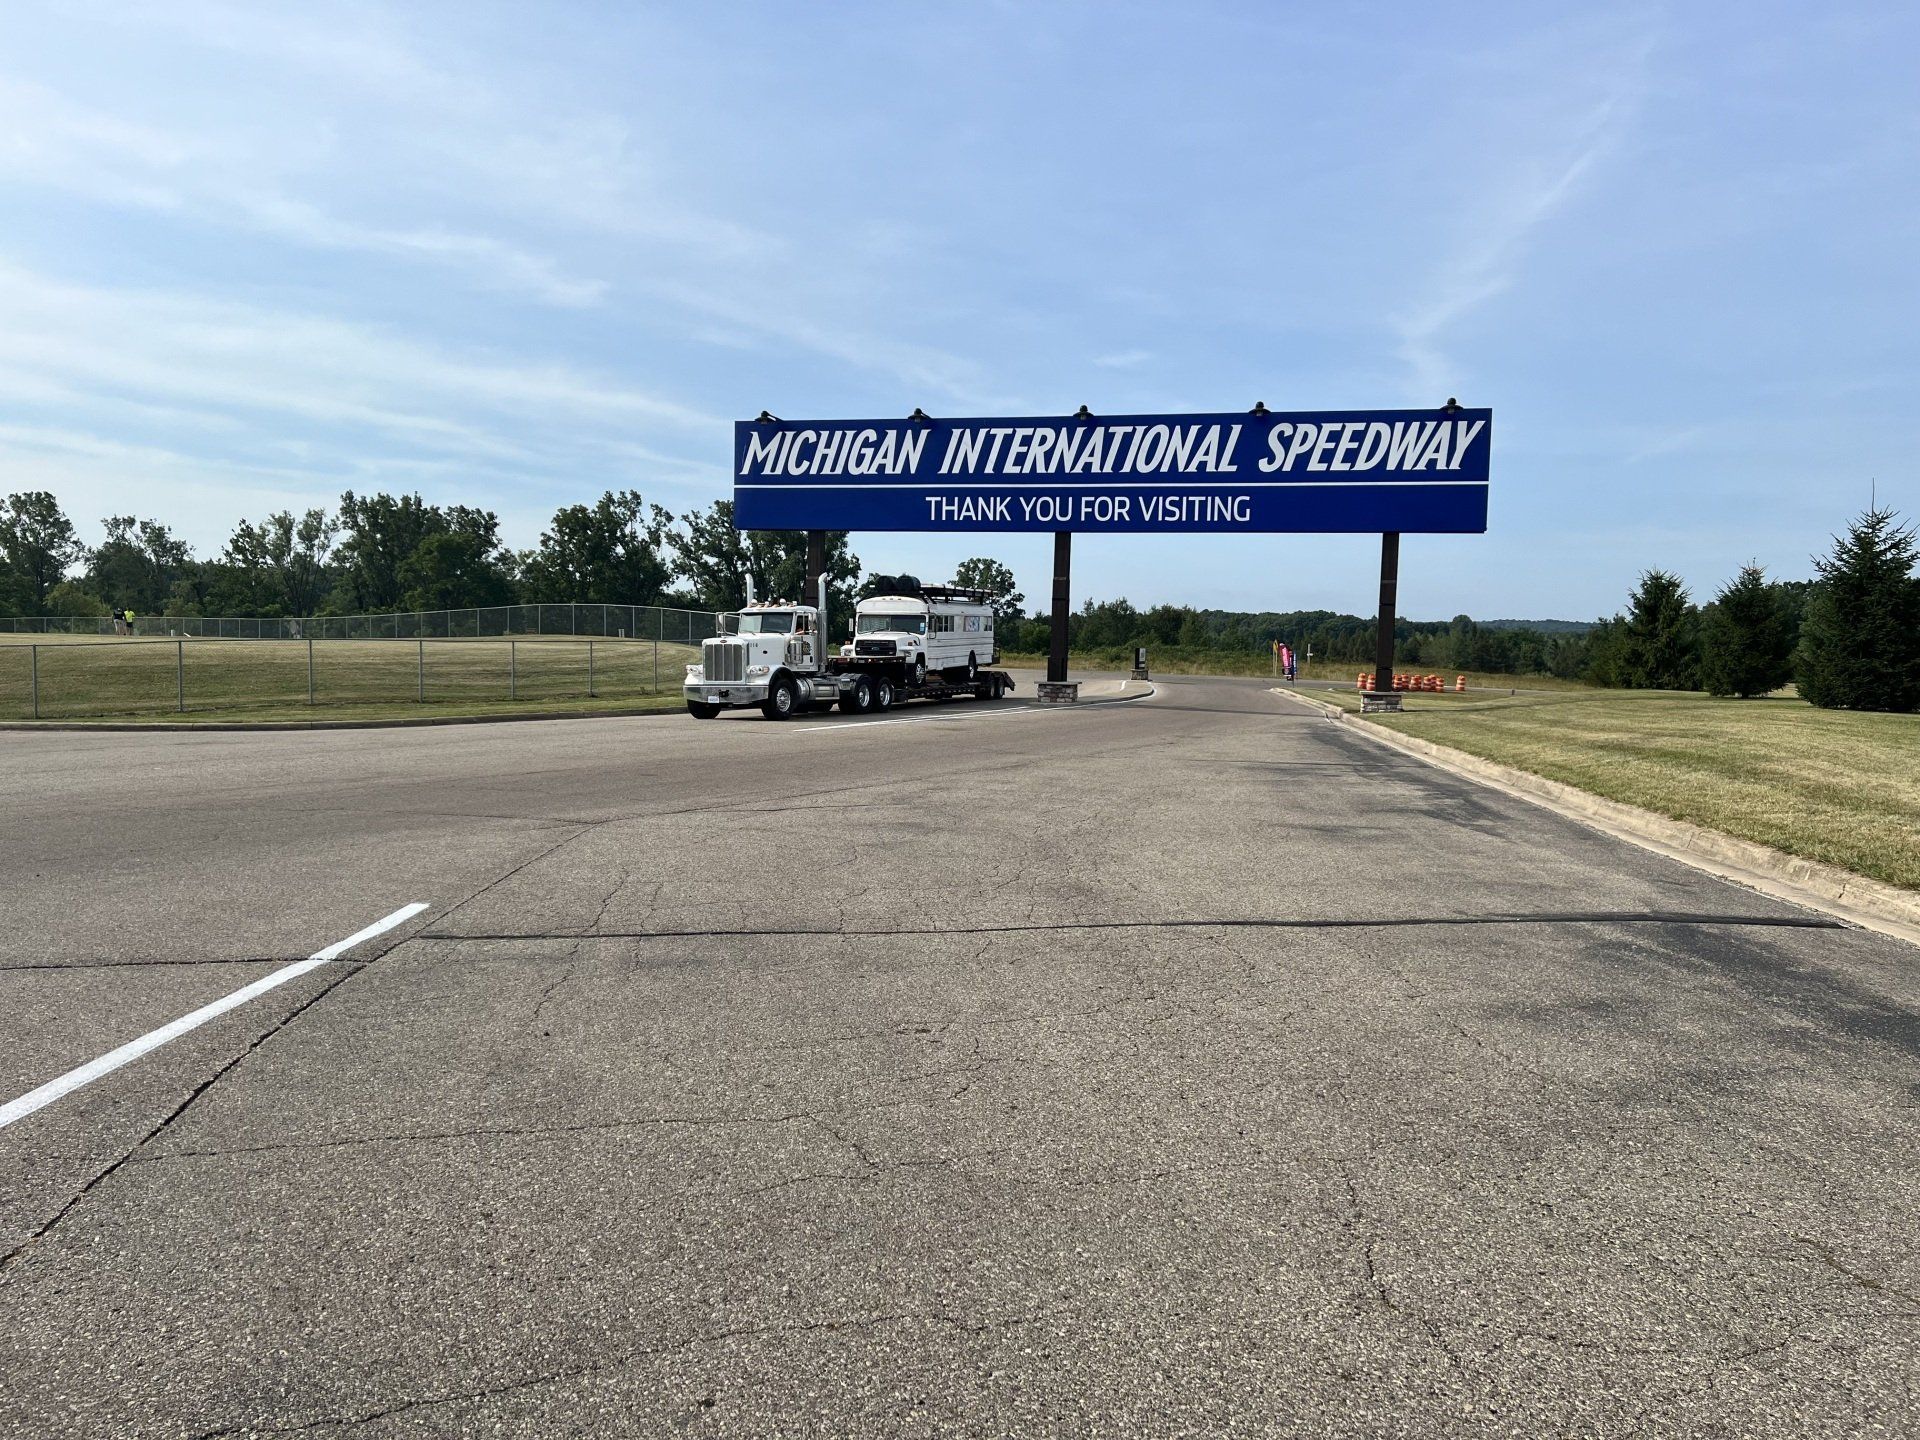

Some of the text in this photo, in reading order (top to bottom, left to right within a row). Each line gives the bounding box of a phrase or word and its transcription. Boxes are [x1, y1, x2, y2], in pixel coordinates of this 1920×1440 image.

[740, 421, 1486, 475] MICHIGAN INTERNATIONAL SPEEDWAY
[925, 495, 1251, 522] THANK YOU FOR VISITING
